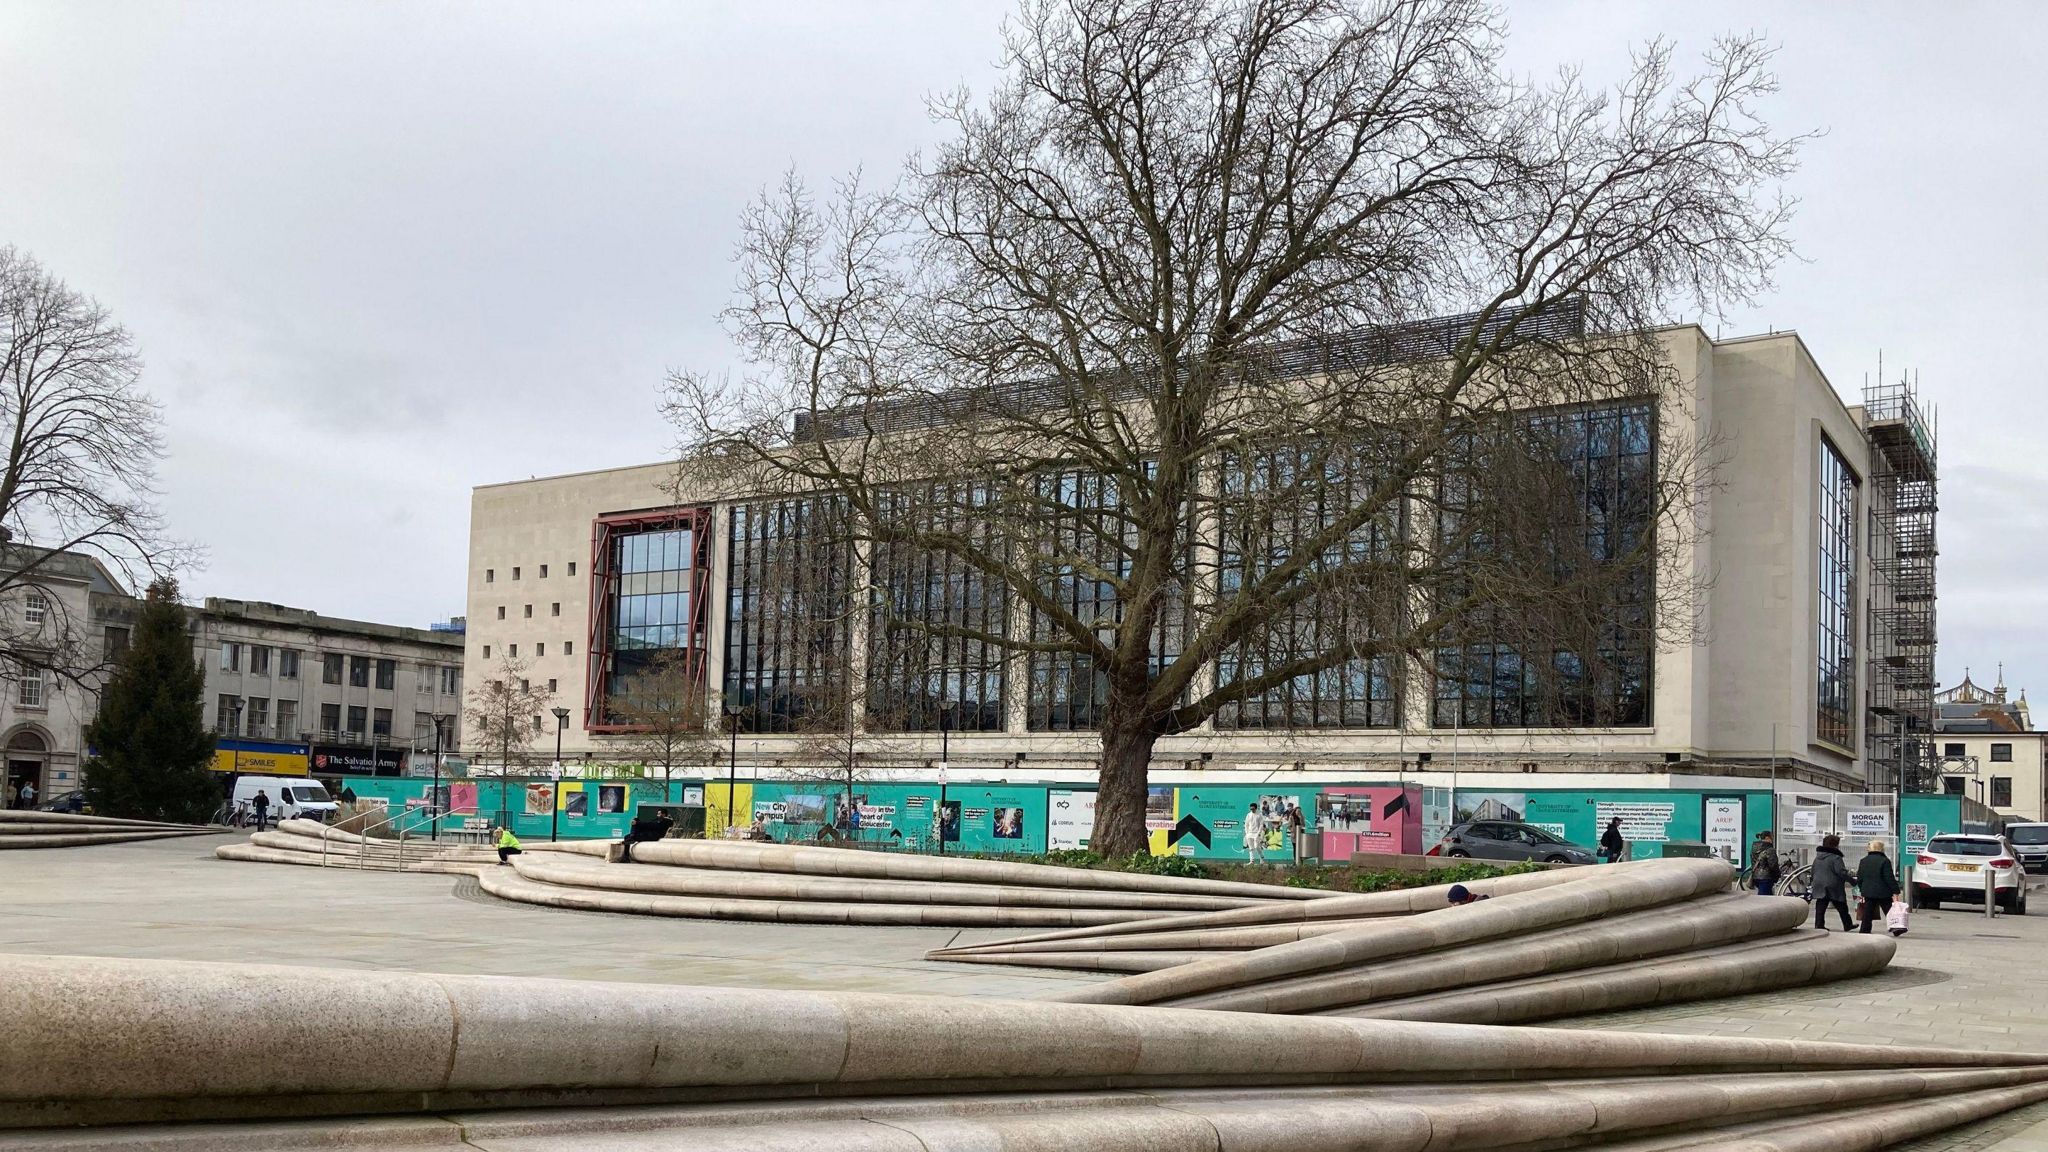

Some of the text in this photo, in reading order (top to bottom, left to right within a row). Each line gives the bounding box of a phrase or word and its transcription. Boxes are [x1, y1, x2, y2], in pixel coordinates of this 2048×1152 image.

[249, 758, 276, 767] SMILES
[328, 755, 343, 764] The
[378, 759, 398, 769] Army
[755, 802, 787, 812] New City
[859, 820, 891, 828] Gloucester
